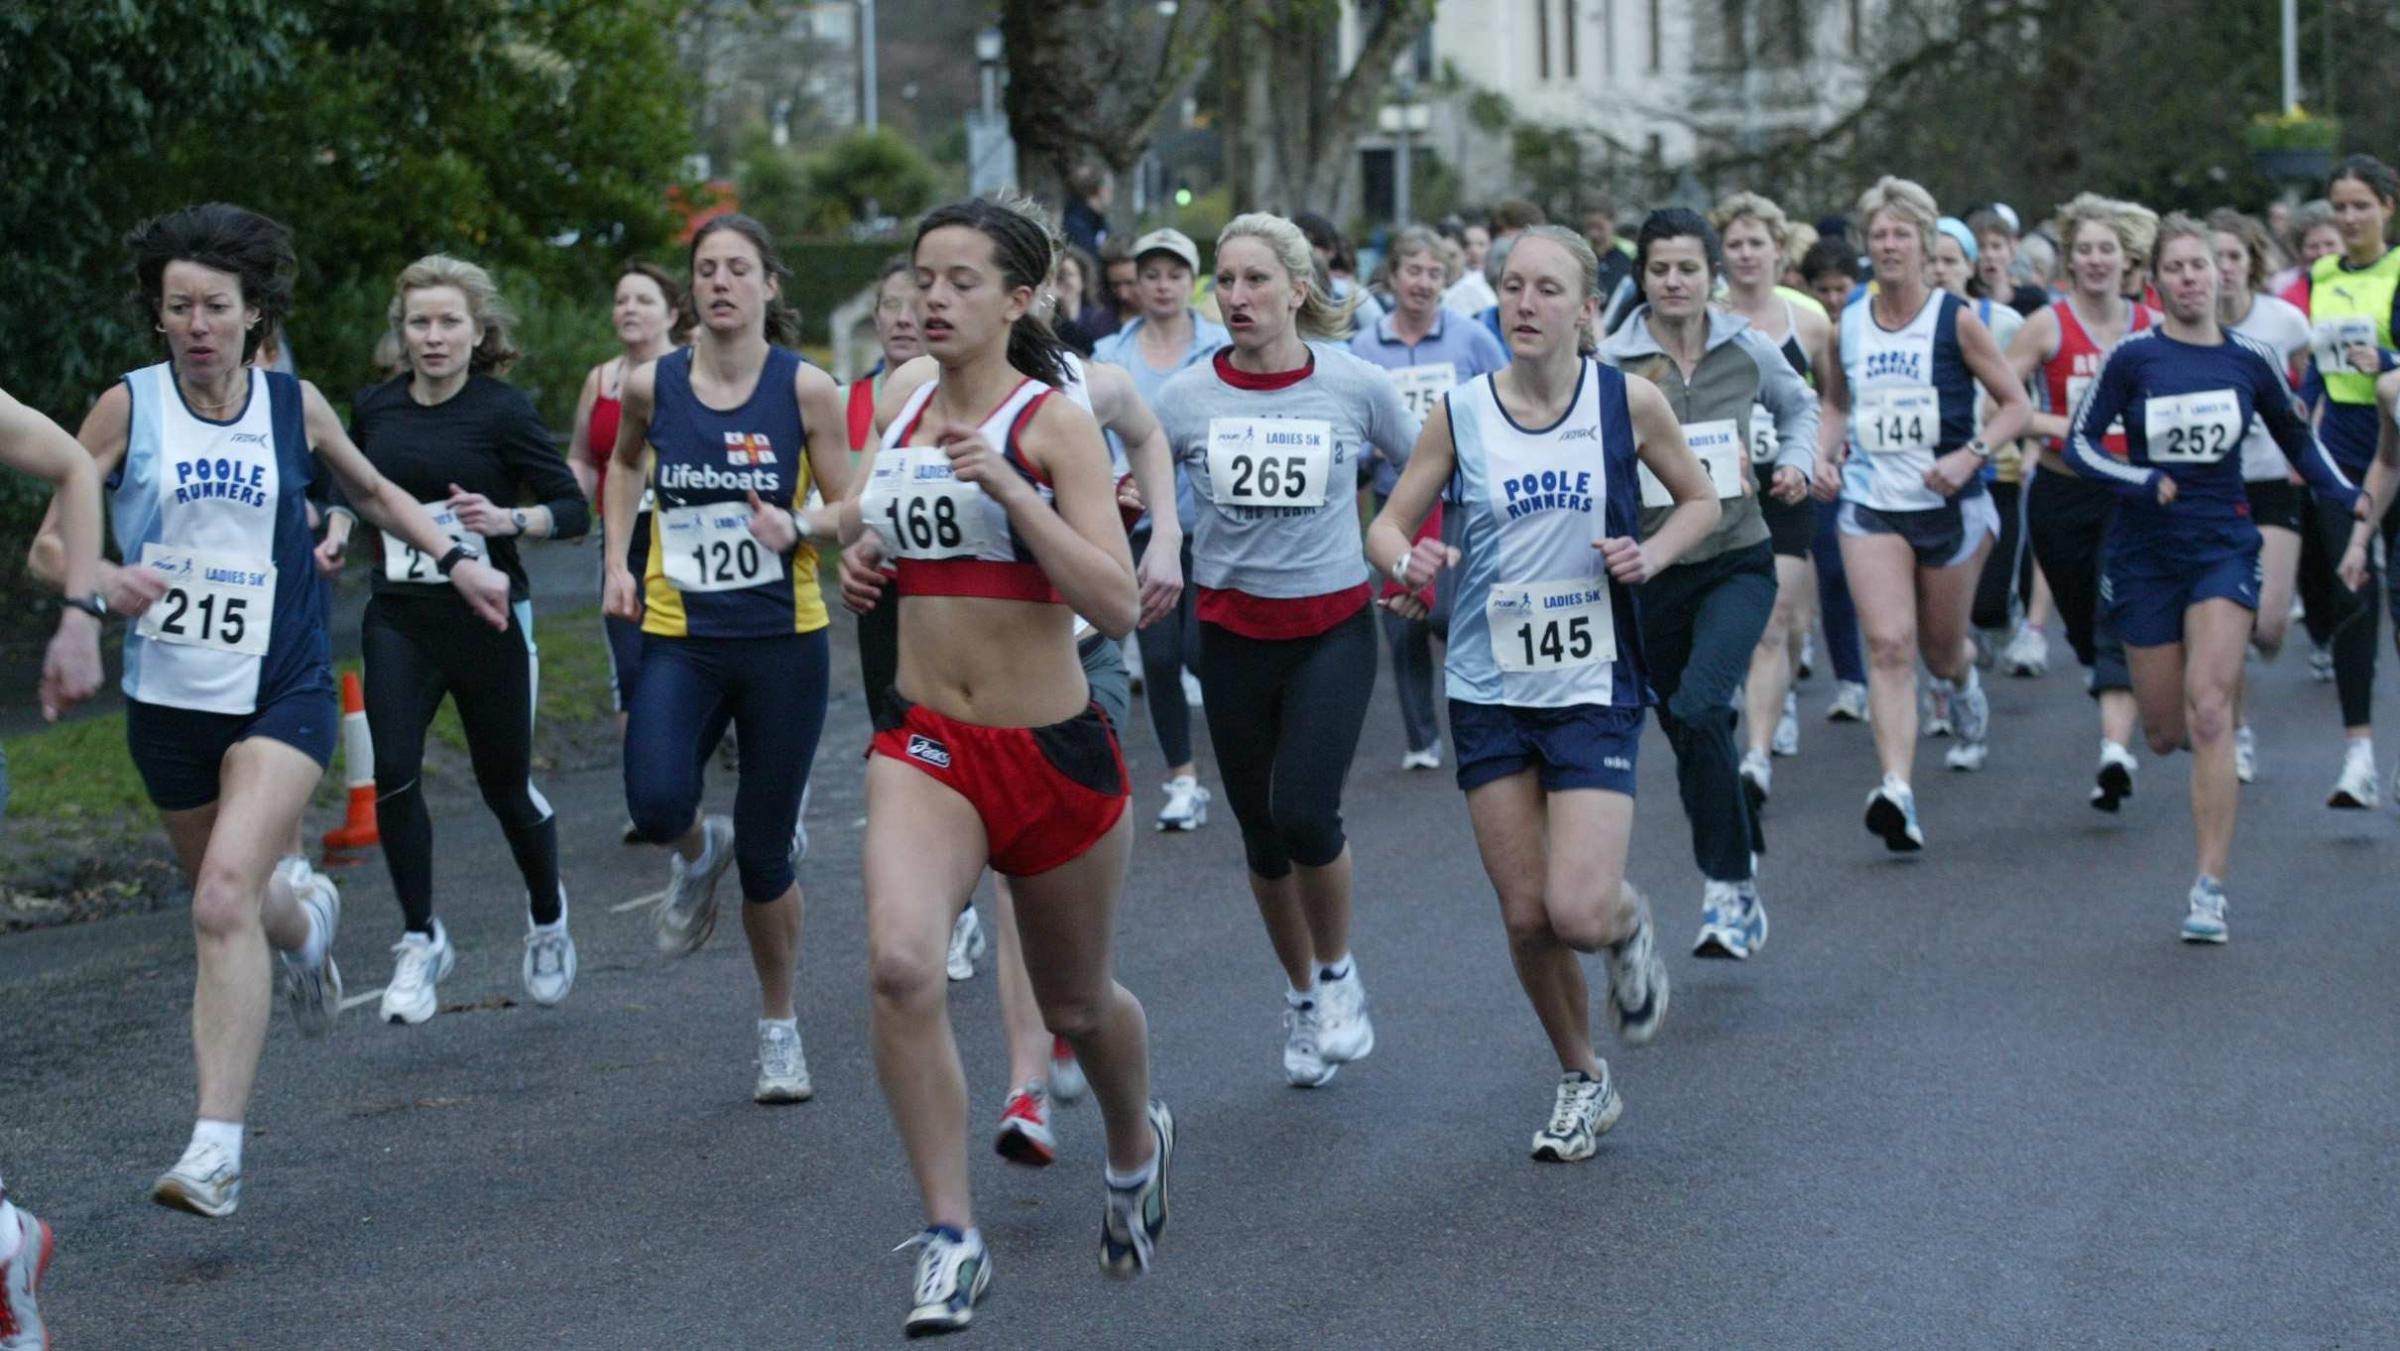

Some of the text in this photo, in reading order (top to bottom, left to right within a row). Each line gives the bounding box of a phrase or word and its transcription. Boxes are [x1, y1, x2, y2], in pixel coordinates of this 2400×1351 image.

[1867, 351, 1920, 367] POOLE
[1266, 432, 1320, 445] LADIES 5K
[1874, 415, 1923, 446] 144
[2167, 423, 2226, 454] 252
[176, 458, 265, 488] POOLE
[661, 464, 780, 491] Lifeboats
[1231, 454, 1306, 498] 265
[1503, 470, 1591, 502] POOLE
[175, 482, 267, 508] RUNNERS
[1506, 493, 1593, 520] RUNNERS
[886, 496, 962, 550] 168
[205, 567, 265, 586] LADIES 5K
[692, 539, 759, 584] 120
[1543, 590, 1601, 609] LADIES 5K
[161, 588, 247, 644] 215
[1517, 616, 1593, 666] 145
